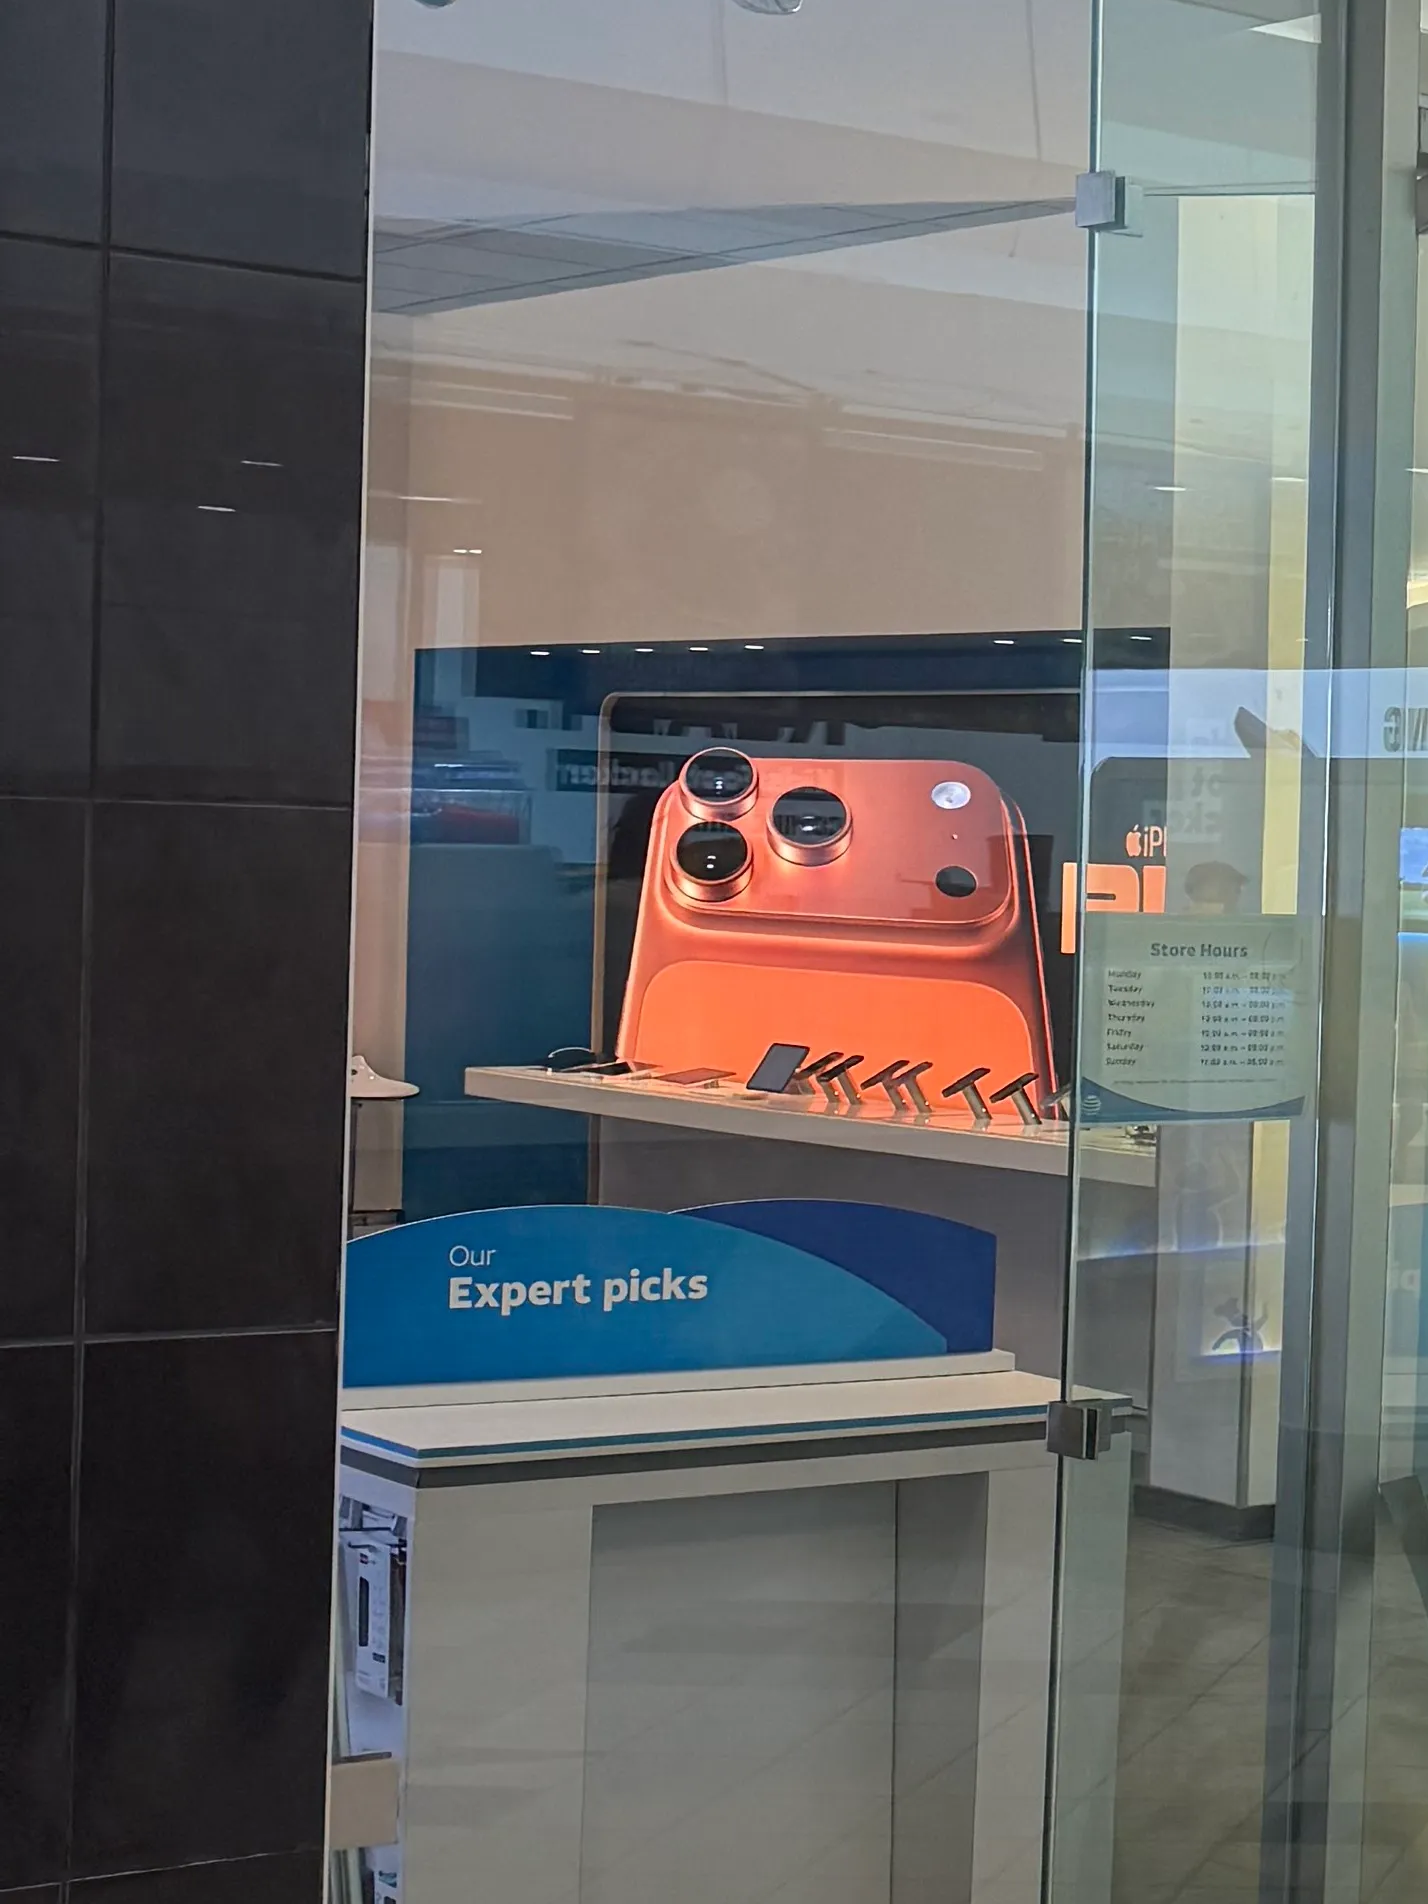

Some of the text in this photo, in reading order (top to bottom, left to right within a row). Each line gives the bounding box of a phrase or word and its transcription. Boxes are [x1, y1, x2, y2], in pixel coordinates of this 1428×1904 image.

[1150, 943, 1248, 957] Store Hours
[449, 1245, 496, 1267] Our
[448, 1267, 708, 1316] Expert picks
